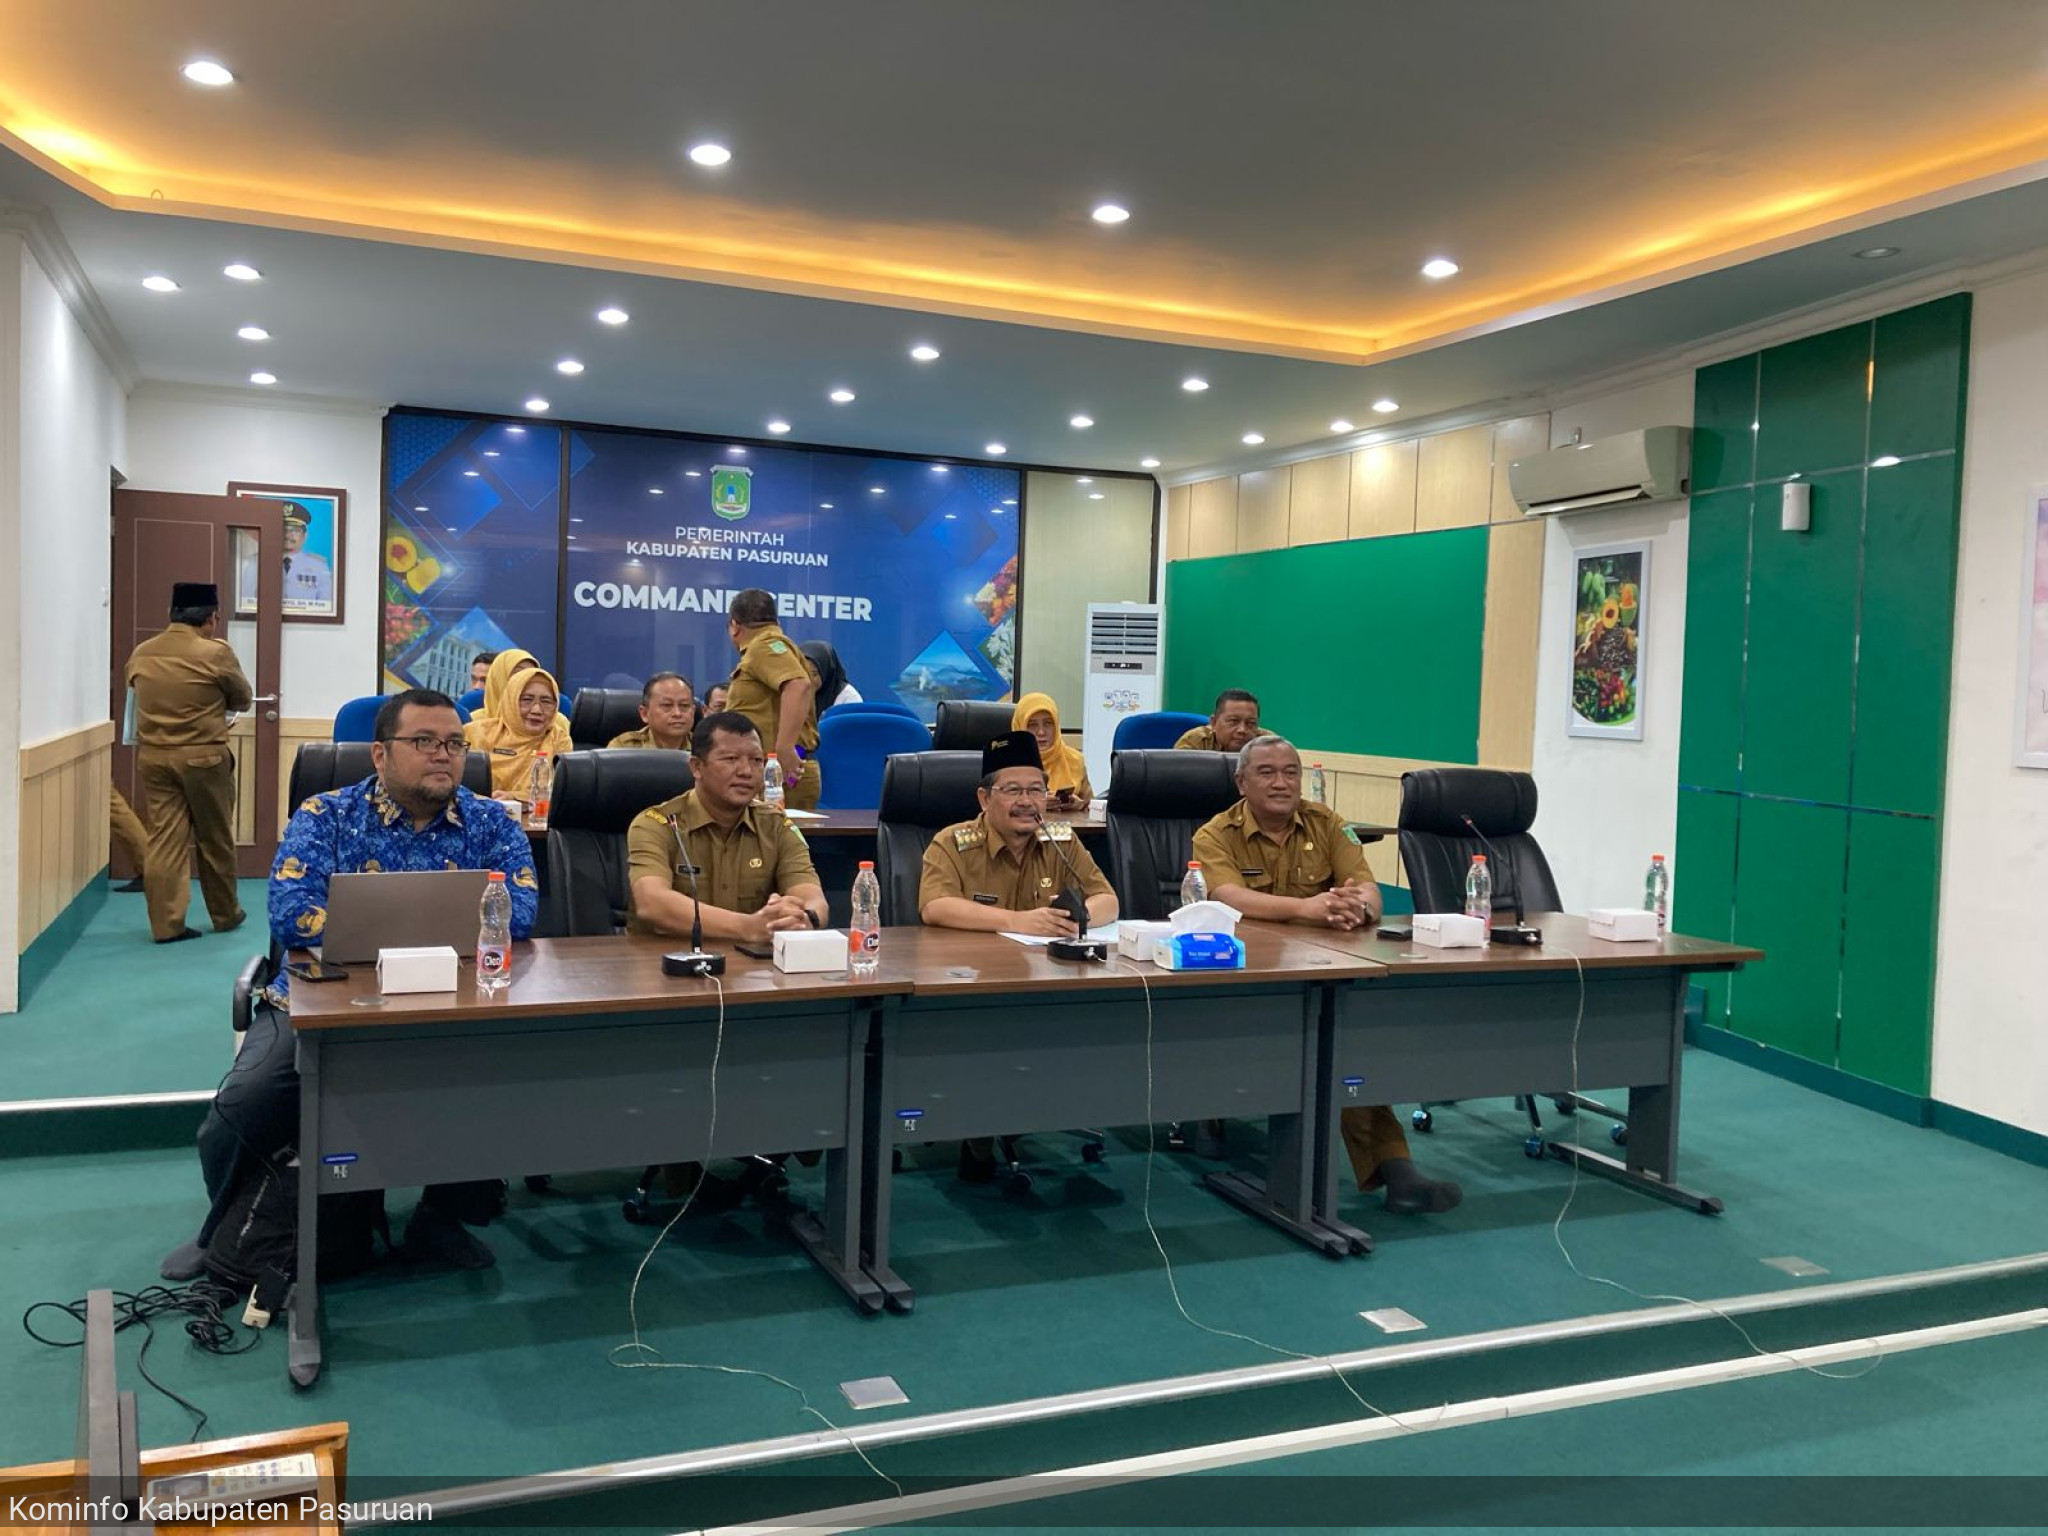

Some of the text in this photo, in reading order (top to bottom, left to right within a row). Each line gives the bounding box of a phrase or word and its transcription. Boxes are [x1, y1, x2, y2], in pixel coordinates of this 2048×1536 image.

[675, 526, 785, 546] PEMERINTAH
[626, 541, 829, 567] KABUPATEN PASURUAN
[767, 591, 872, 621] ENTER
